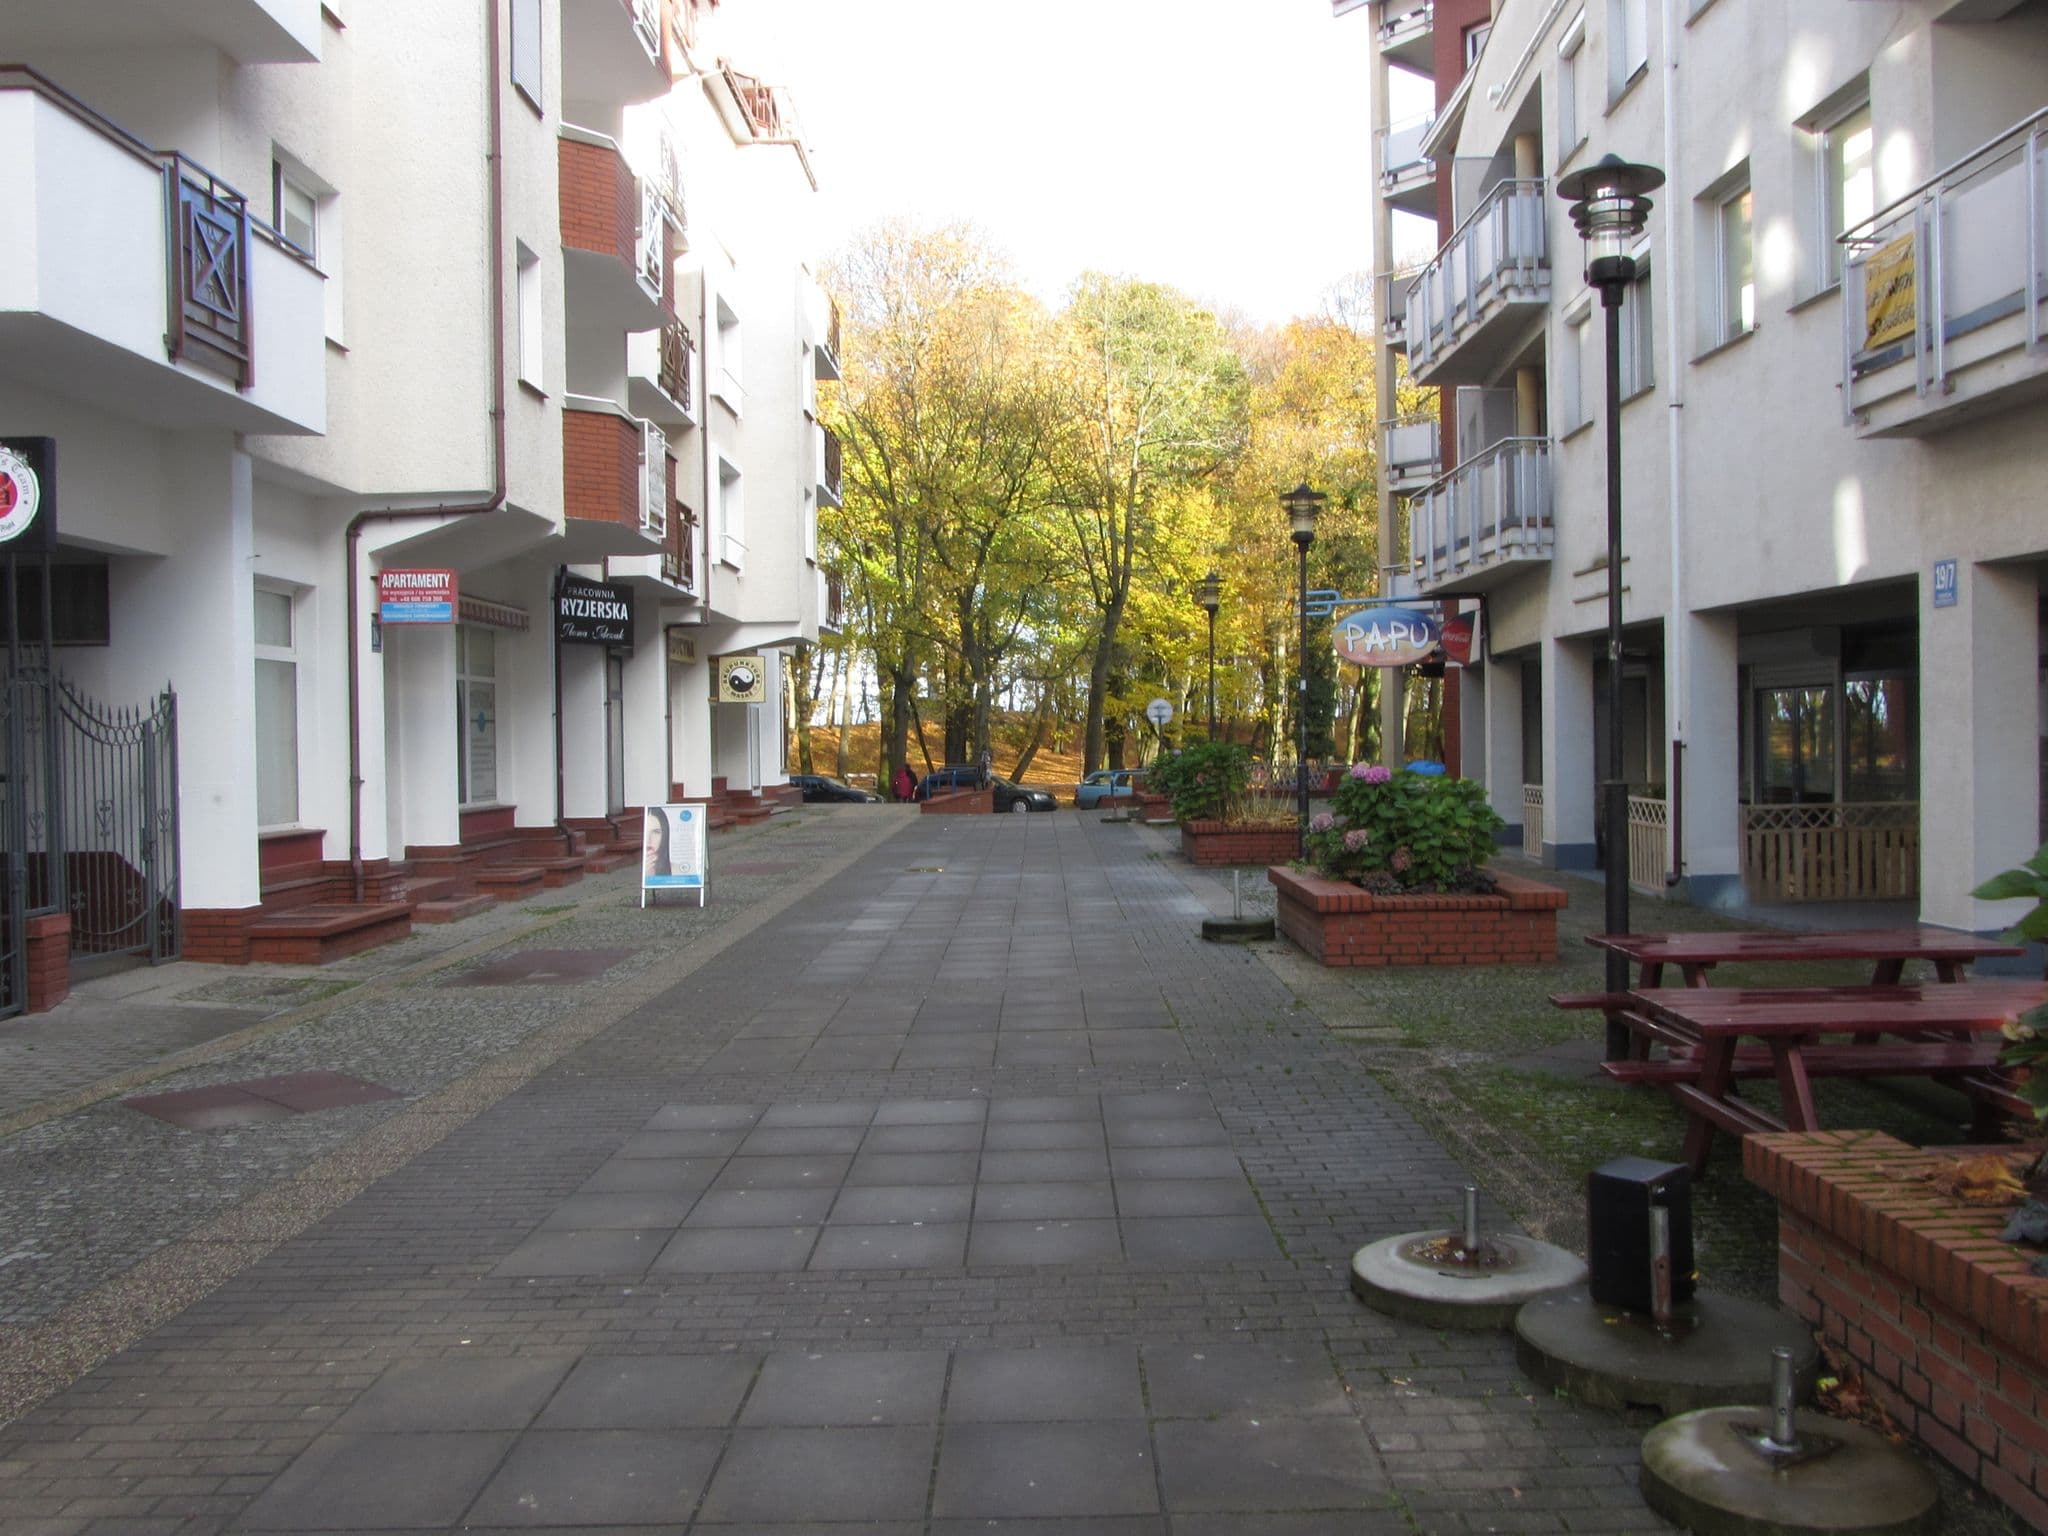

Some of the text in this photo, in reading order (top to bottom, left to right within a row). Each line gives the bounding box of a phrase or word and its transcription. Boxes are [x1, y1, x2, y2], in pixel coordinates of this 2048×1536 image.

[382, 573, 450, 588] APARTAMENTY
[568, 587, 616, 599] PRACOWNIA
[561, 598, 629, 620] RYZJERSKA
[1344, 621, 1429, 653] PAPU
